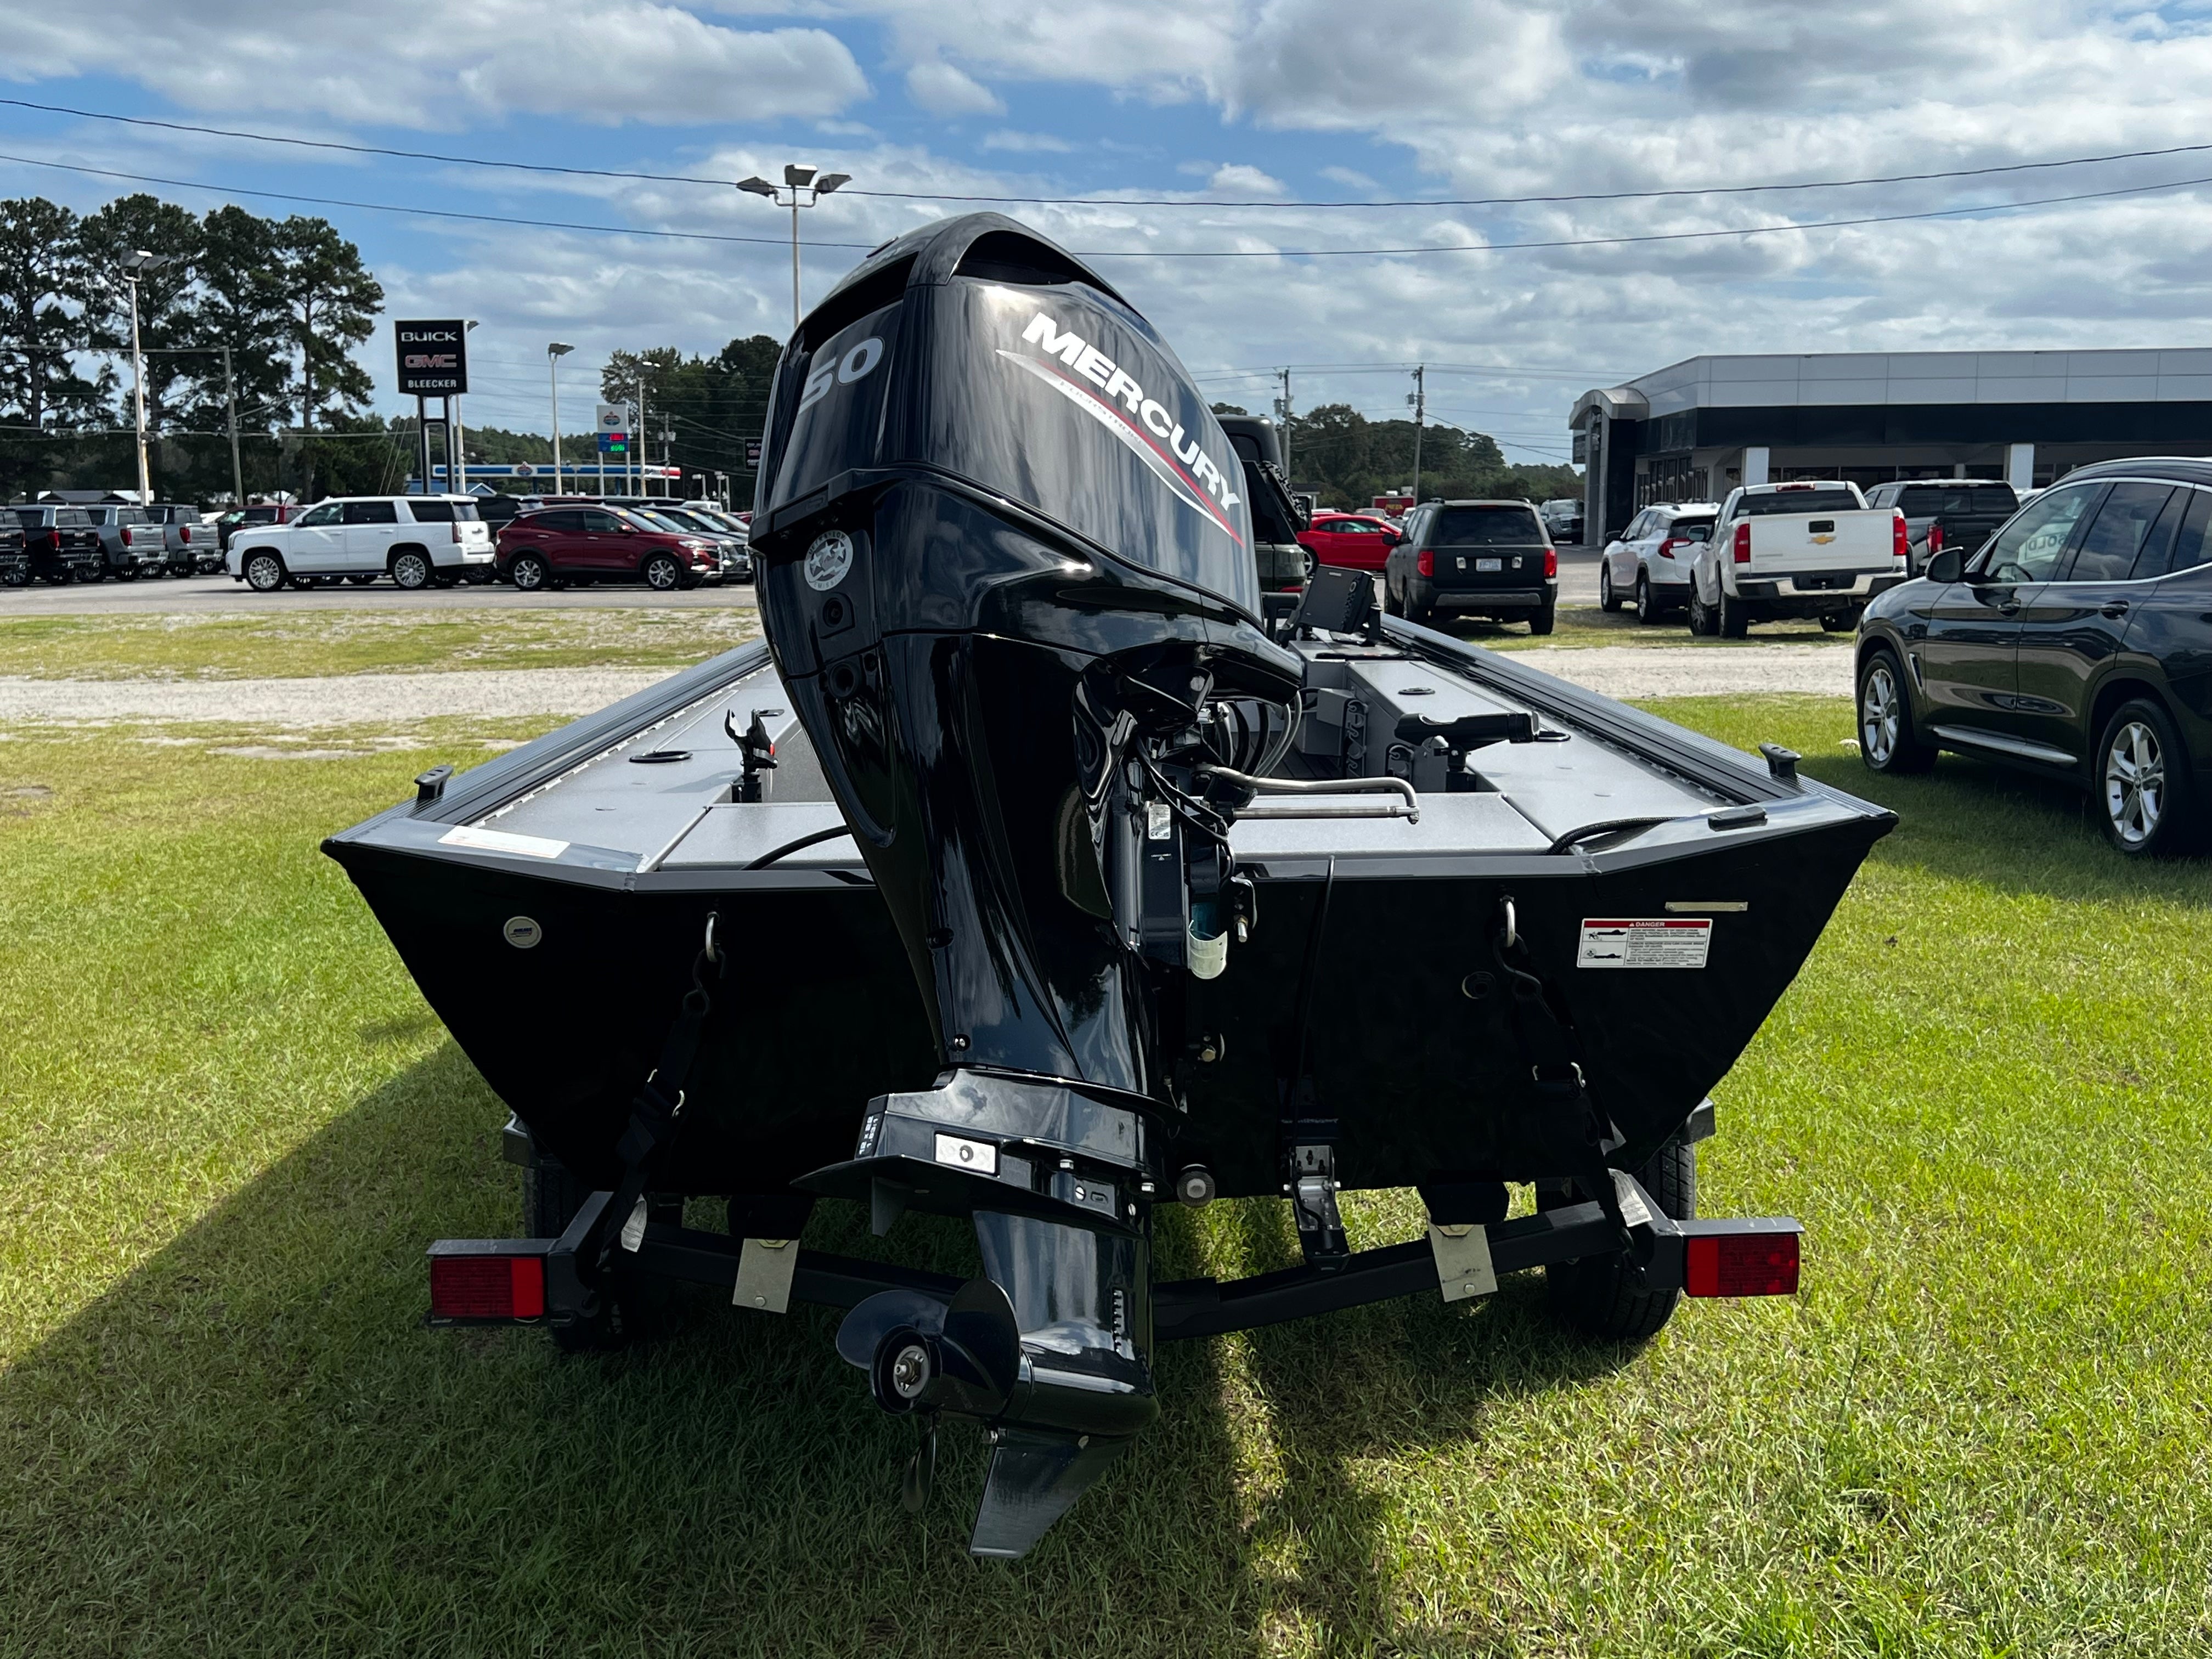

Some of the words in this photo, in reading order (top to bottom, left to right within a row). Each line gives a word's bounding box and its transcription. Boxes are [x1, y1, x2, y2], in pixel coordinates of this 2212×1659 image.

[401, 331, 458, 342] BUICK
[405, 354, 457, 368] GMC
[798, 337, 884, 415] 50
[408, 379, 457, 388] BLEECKER
[1022, 312, 1241, 511] MERCURY
